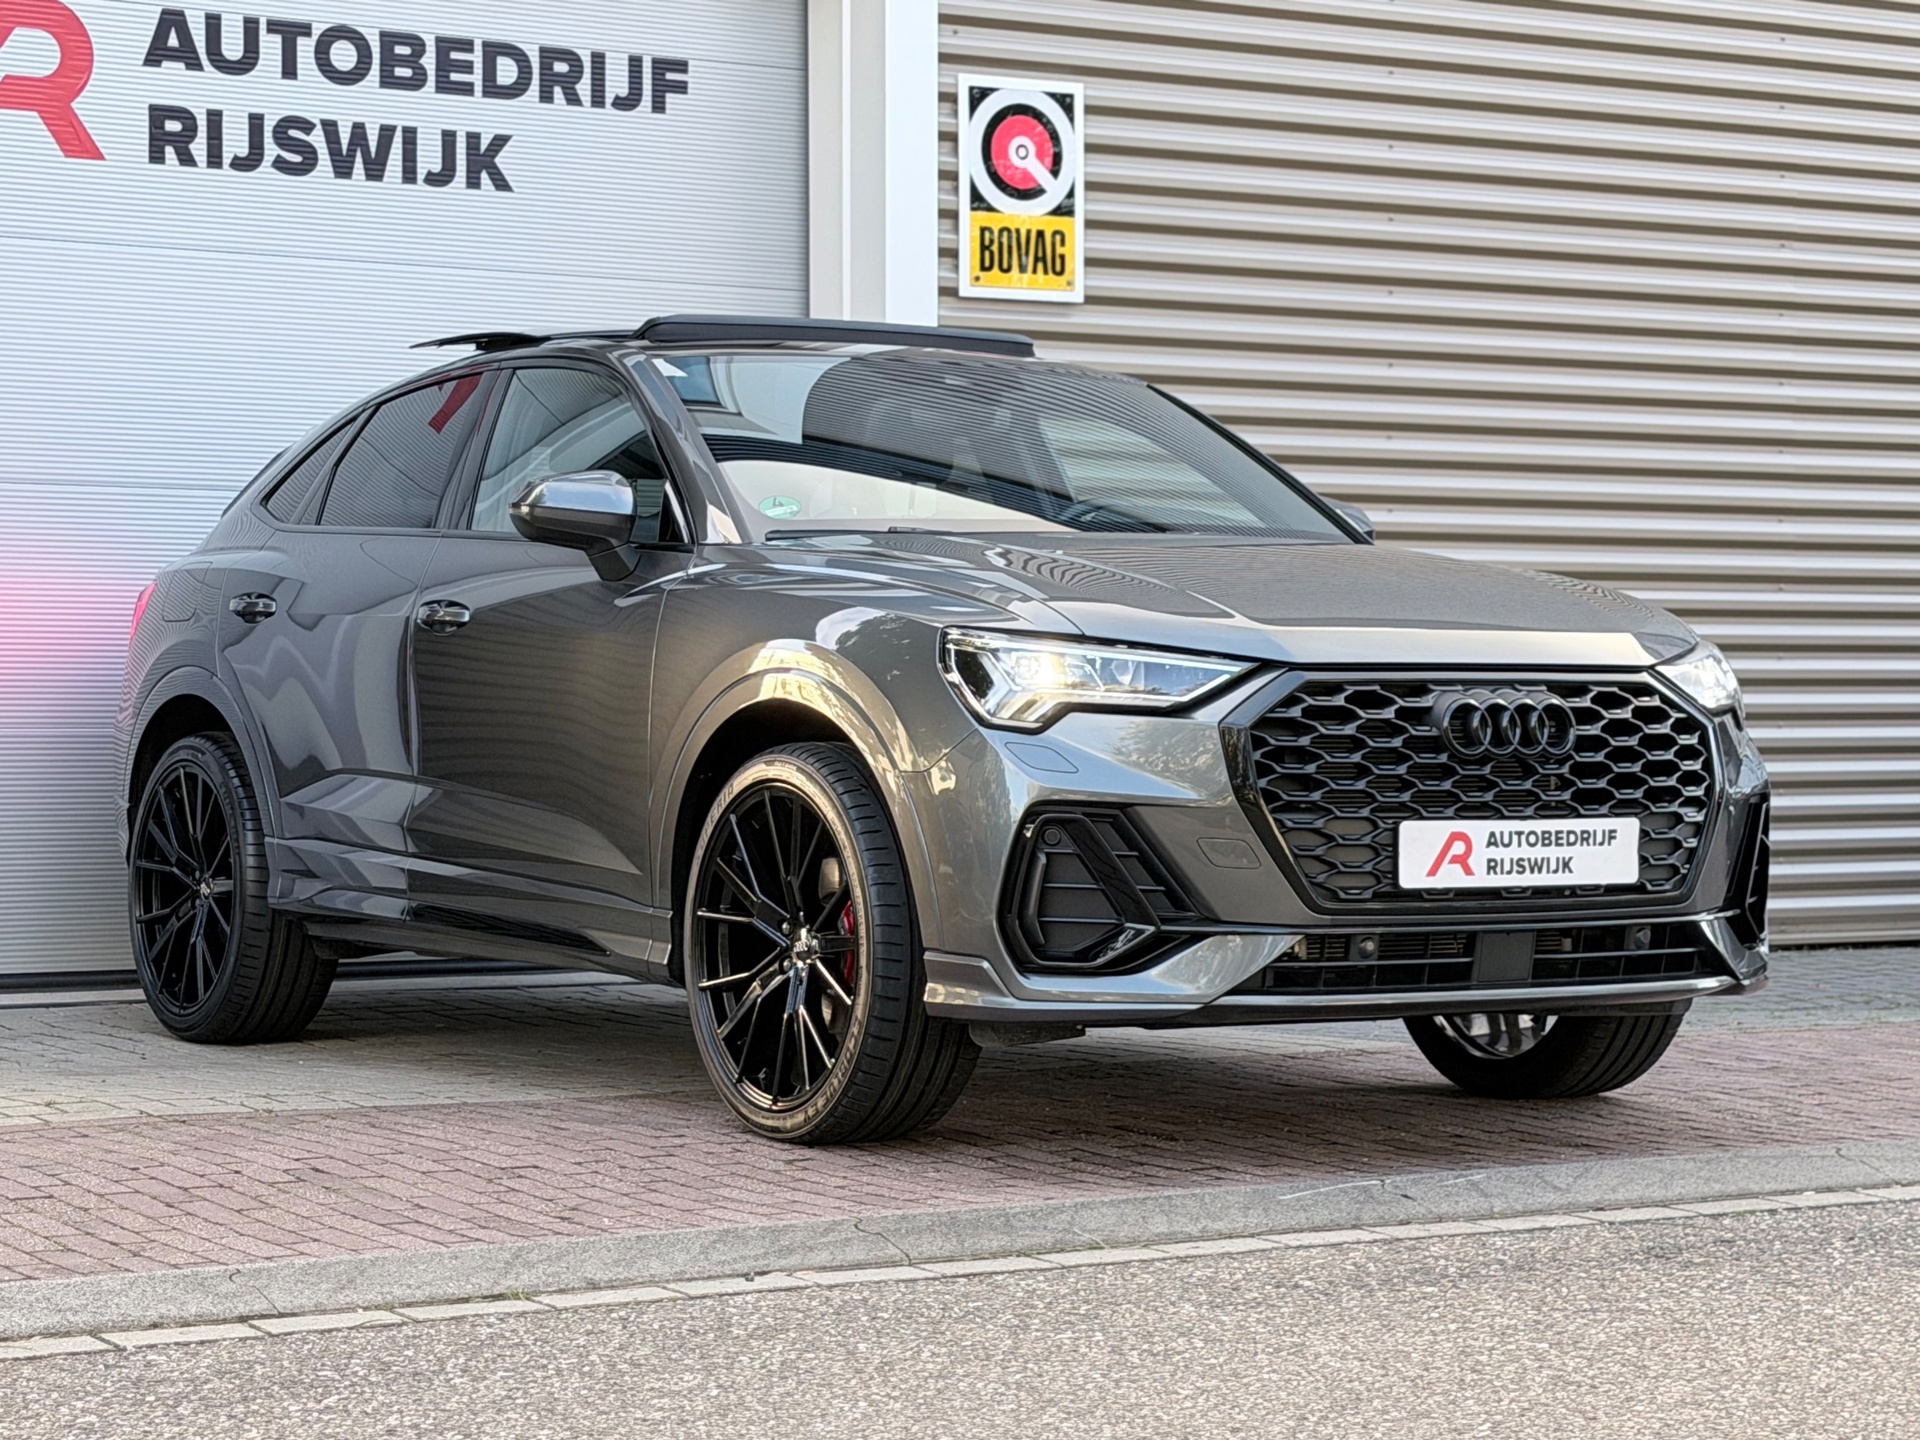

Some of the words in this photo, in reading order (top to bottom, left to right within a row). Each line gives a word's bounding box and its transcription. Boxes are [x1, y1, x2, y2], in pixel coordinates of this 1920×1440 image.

[143, 8, 690, 115] AUTOBEDRIJF
[148, 104, 515, 193] RIJSWIJK
[979, 225, 1067, 277] BOVAG
[1485, 829, 1618, 849] AUTOBEDRIJF
[1486, 856, 1575, 876] RIJSWIJK
